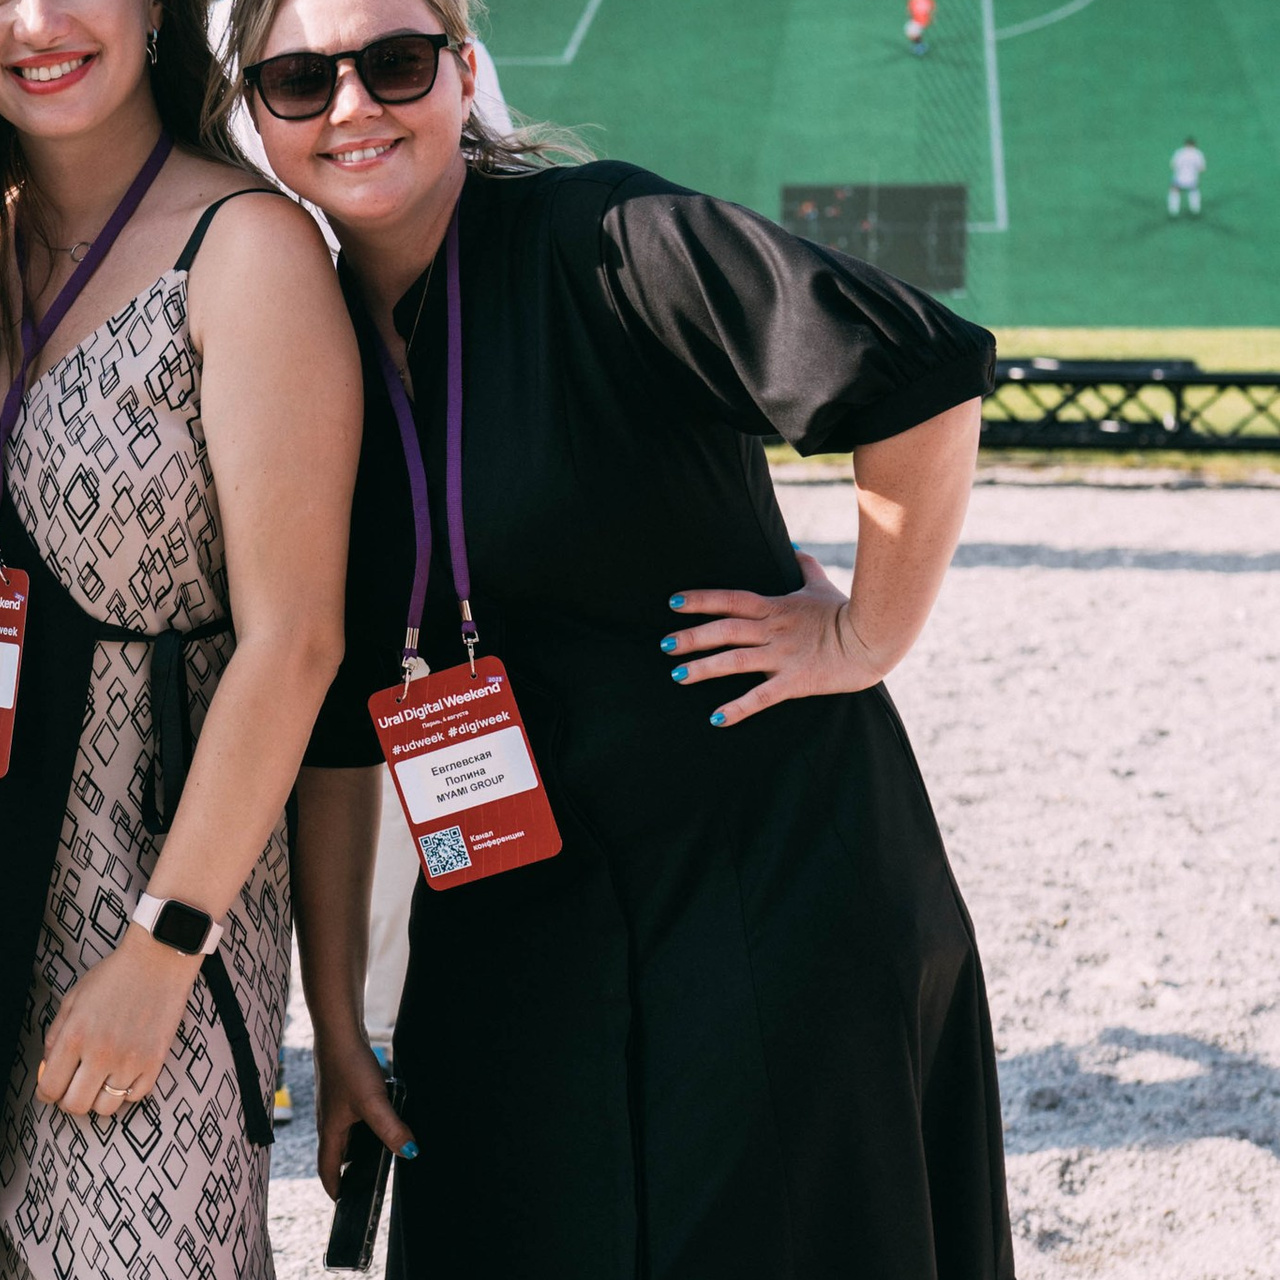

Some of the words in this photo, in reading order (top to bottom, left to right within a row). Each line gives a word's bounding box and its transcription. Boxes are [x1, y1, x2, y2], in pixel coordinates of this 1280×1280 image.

[378, 712, 404, 729] Ural
[404, 699, 444, 721] Digital
[443, 682, 501, 708] Weekend
[392, 732, 445, 756] #udweek
[448, 711, 510, 738] #digiweek
[431, 750, 493, 777] Евглевская
[445, 767, 487, 787] Полина
[436, 786, 469, 803] MYAMI
[470, 774, 505, 792] GROUP
[469, 830, 494, 843] Канал
[472, 830, 525, 851] конференции
